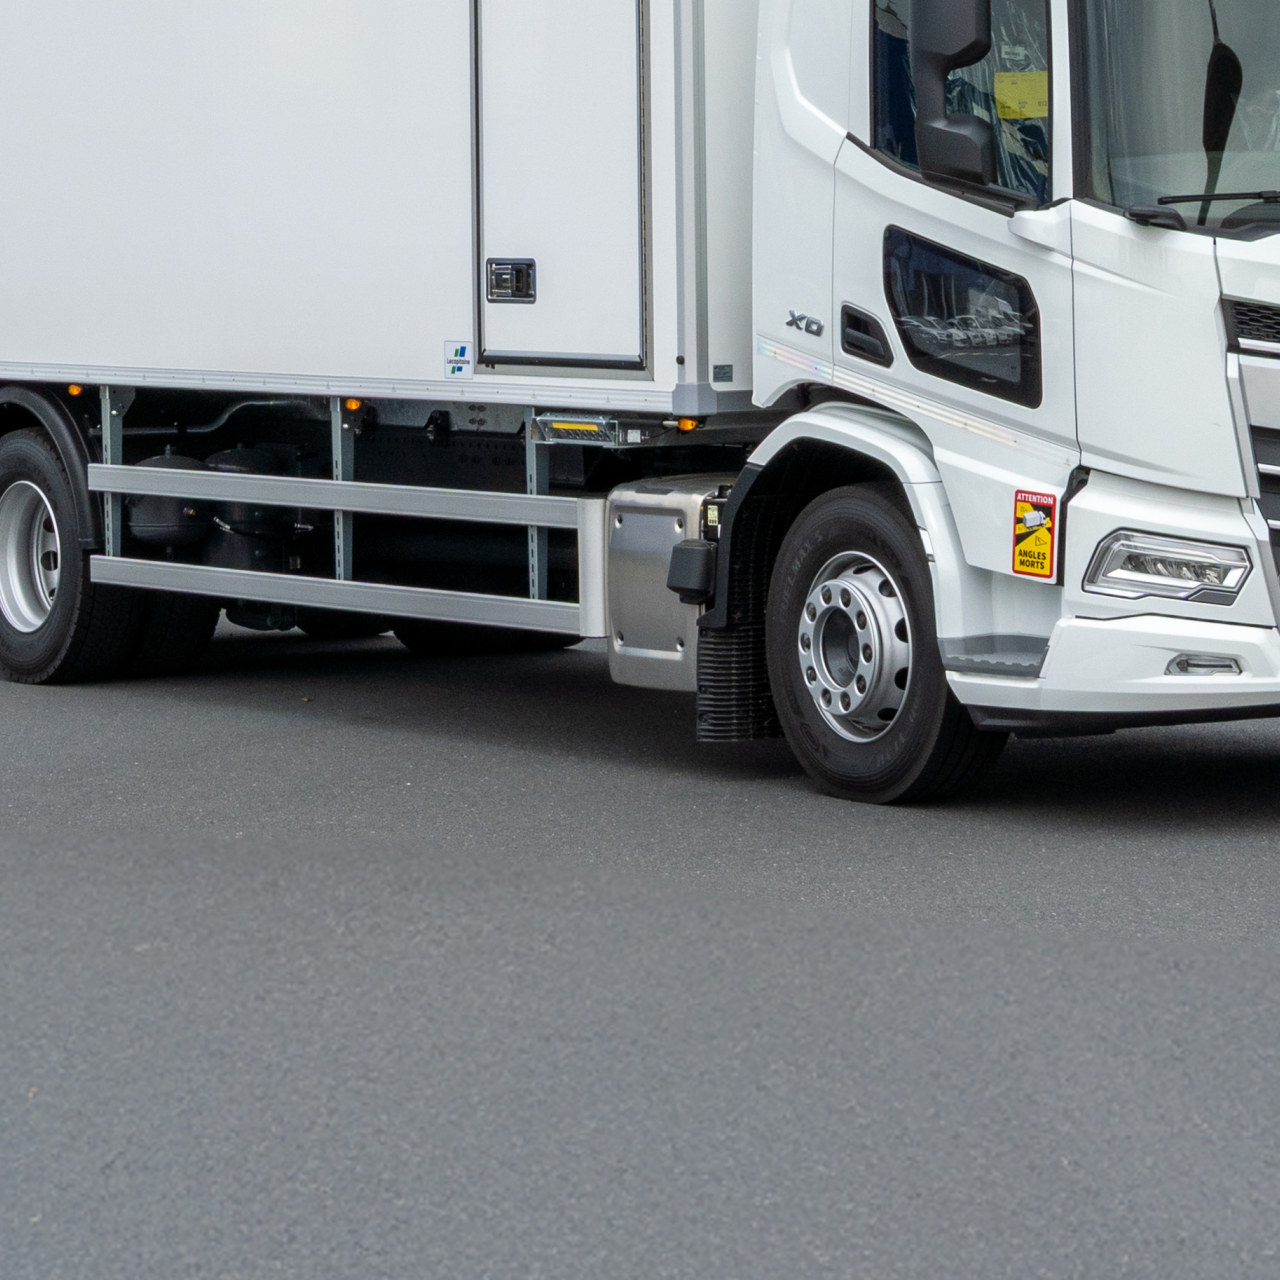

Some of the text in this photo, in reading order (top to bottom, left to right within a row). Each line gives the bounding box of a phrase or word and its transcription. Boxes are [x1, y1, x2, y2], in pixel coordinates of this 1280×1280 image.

[785, 310, 824, 337] XD
[1017, 492, 1054, 505] ATTENTION
[1018, 549, 1047, 561] ANGLES
[1019, 559, 1045, 570] MORTS
